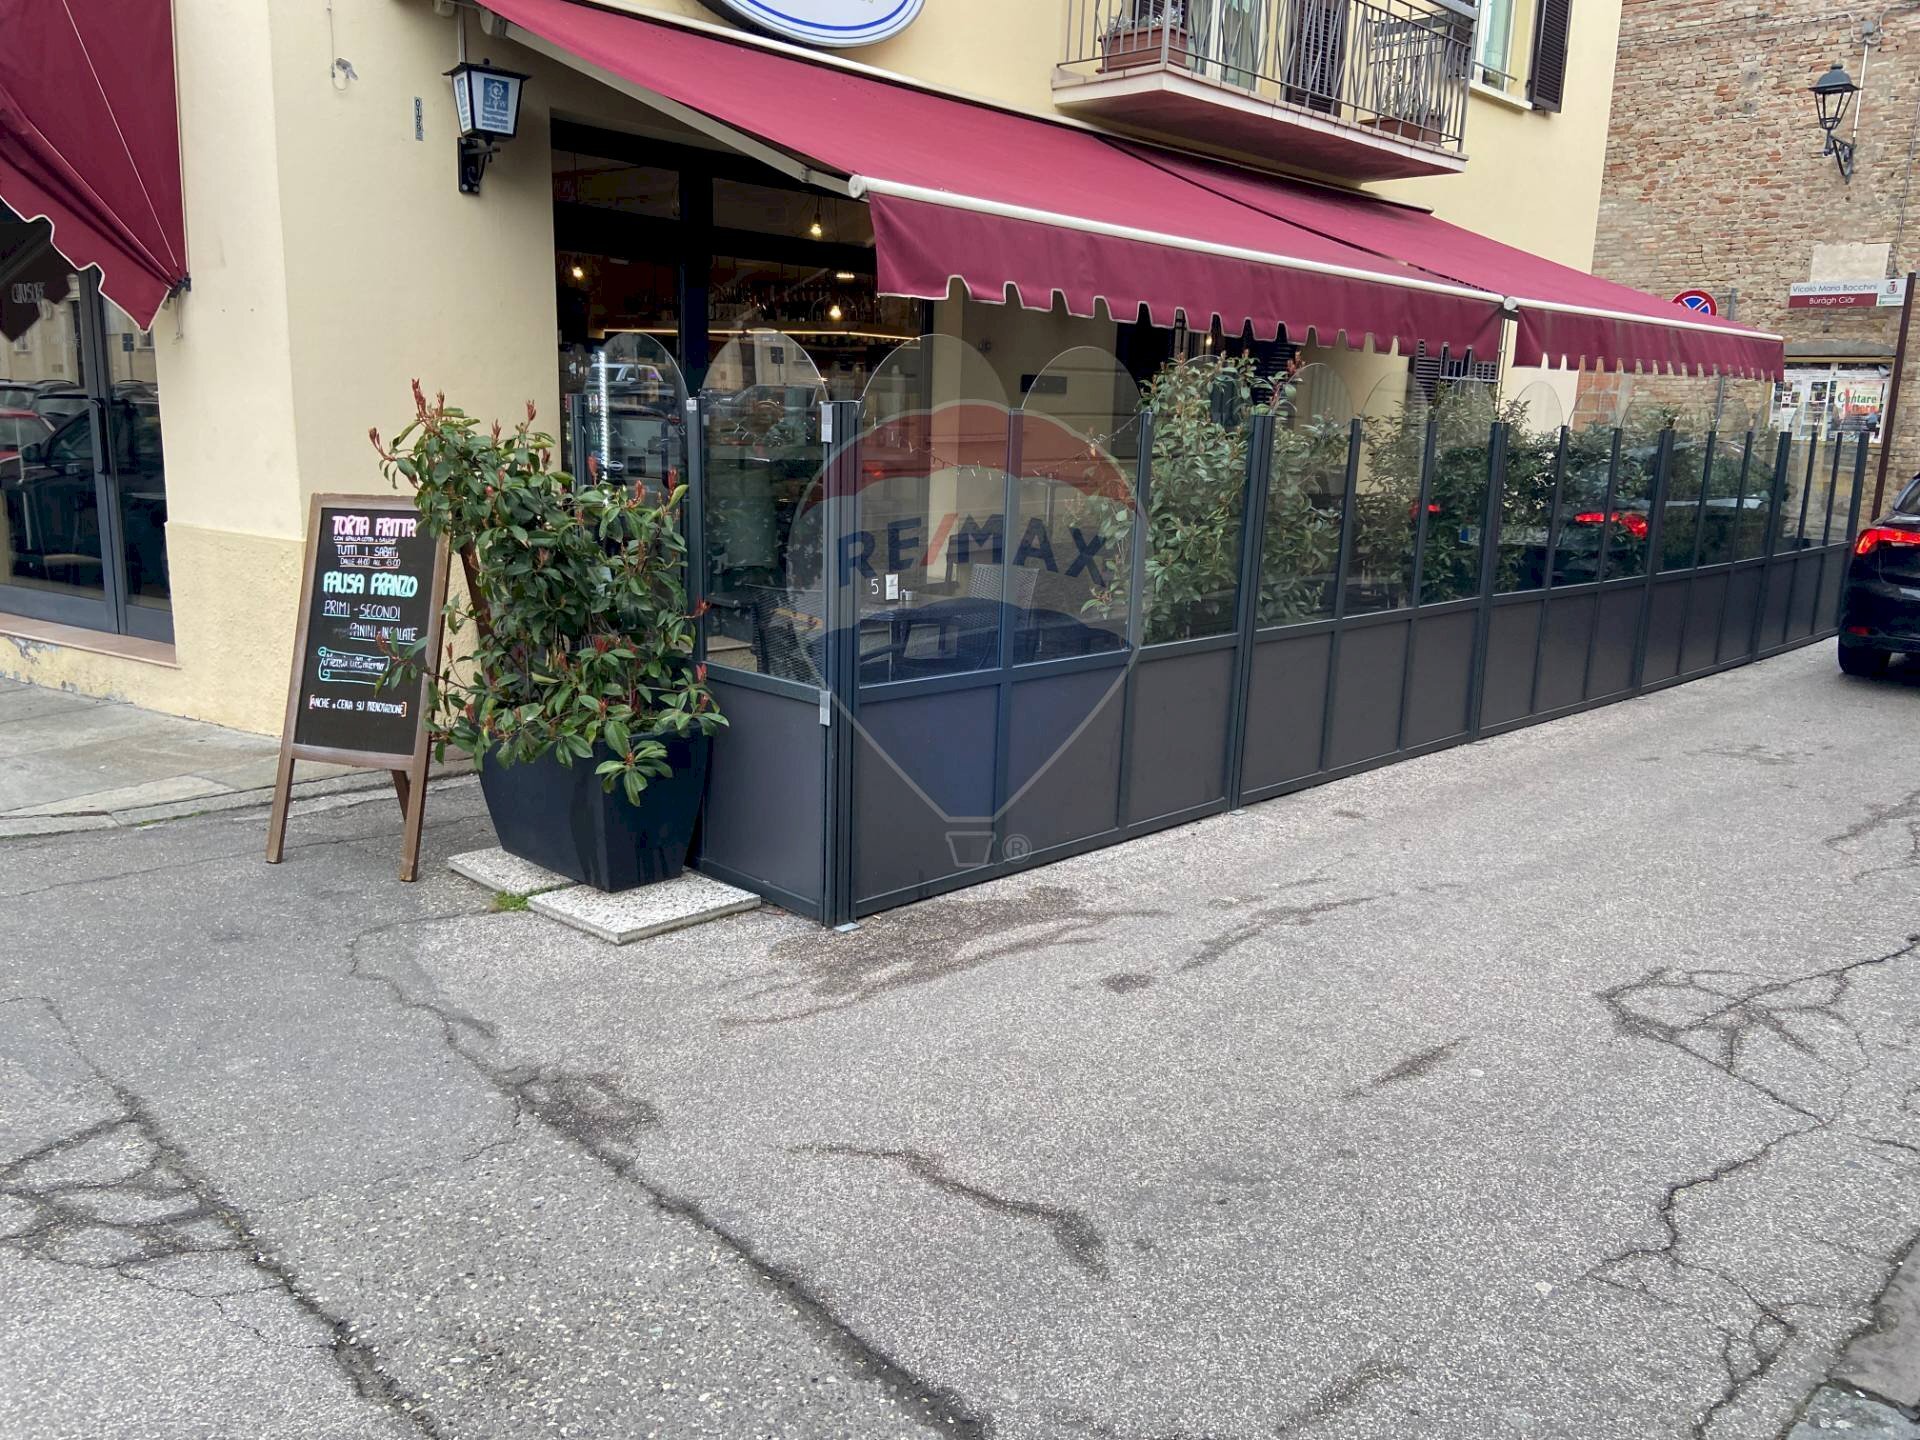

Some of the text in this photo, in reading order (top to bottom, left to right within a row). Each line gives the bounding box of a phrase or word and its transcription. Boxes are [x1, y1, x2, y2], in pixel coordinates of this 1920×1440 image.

[1792, 285, 1817, 293] Vicolo
[1843, 283, 1878, 291] Bacchini
[332, 515, 417, 538] TORTA FRITTA
[336, 544, 358, 555] TUTTI
[323, 571, 419, 598] PAUSA PRANZO
[324, 600, 350, 615] PRIMI
[359, 603, 401, 619] SECONDI
[349, 622, 376, 637] PANINI
